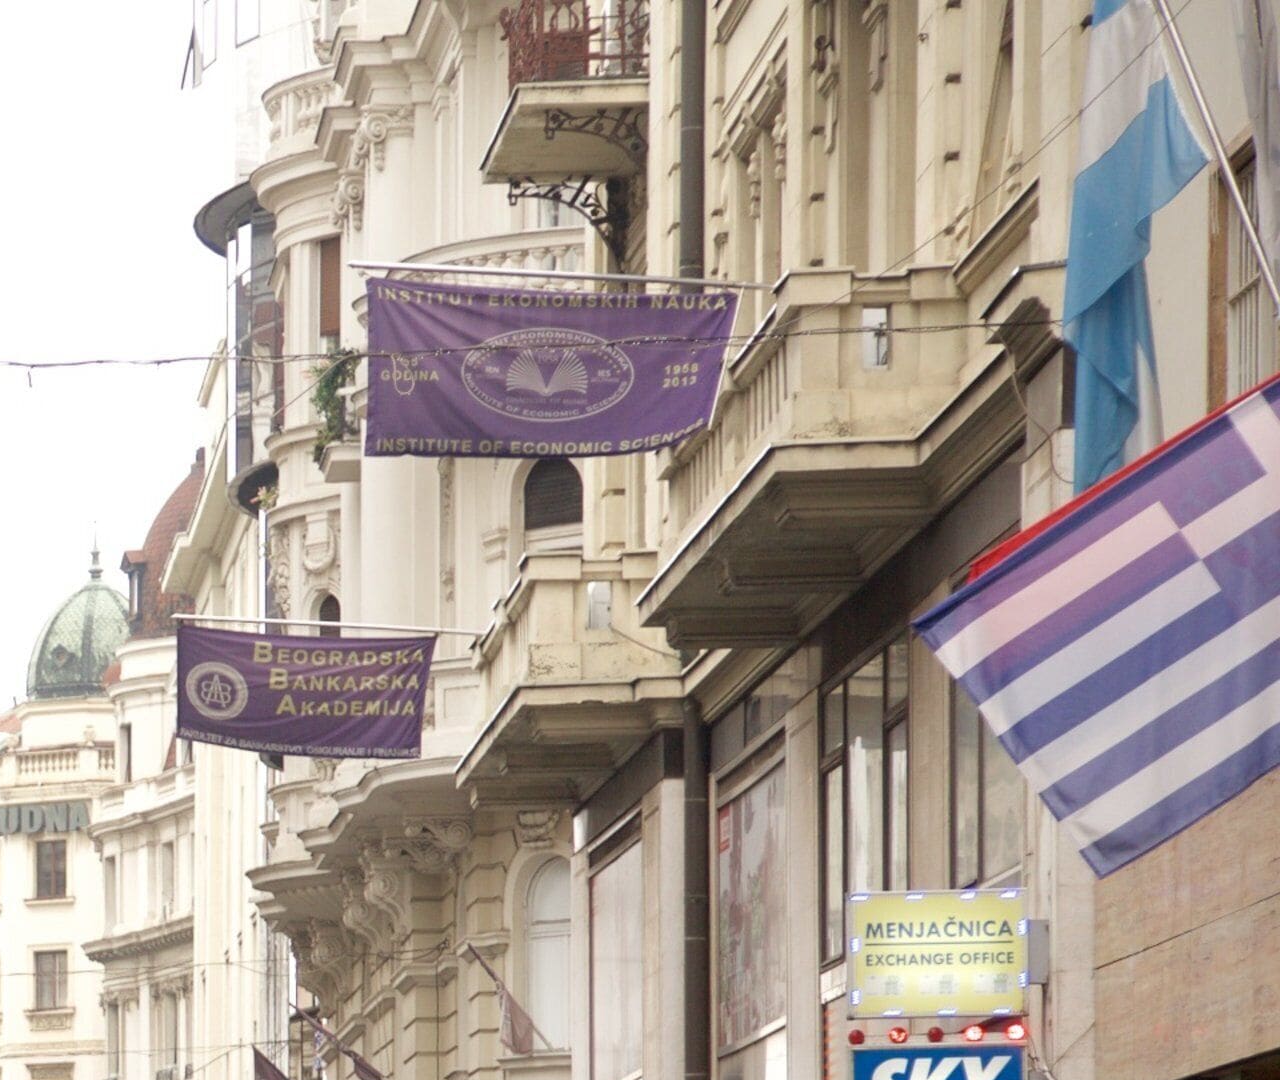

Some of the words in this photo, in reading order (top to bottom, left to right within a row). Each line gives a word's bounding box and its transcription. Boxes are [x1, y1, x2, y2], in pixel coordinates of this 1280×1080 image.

[376, 286, 475, 306] INSTITUT
[488, 293, 639, 309] EKONOMSKIH
[650, 296, 728, 311] NAUKA
[380, 369, 440, 382] GODINA
[661, 375, 698, 389] 2013
[522, 408, 580, 418] ECONOMIC
[376, 438, 472, 453] INSTITUTE
[479, 440, 503, 453] OF
[510, 440, 613, 455] ECONOMIC
[618, 417, 706, 451] SCIENCES
[253, 641, 425, 667] BEOGRADSKA
[268, 667, 420, 691] BANKARSKA
[275, 694, 417, 716] AKADEMIJA
[865, 916, 1014, 939] MENJAČNICA
[865, 953, 955, 967] EXCHANGE
[959, 950, 1015, 965] OFFICE
